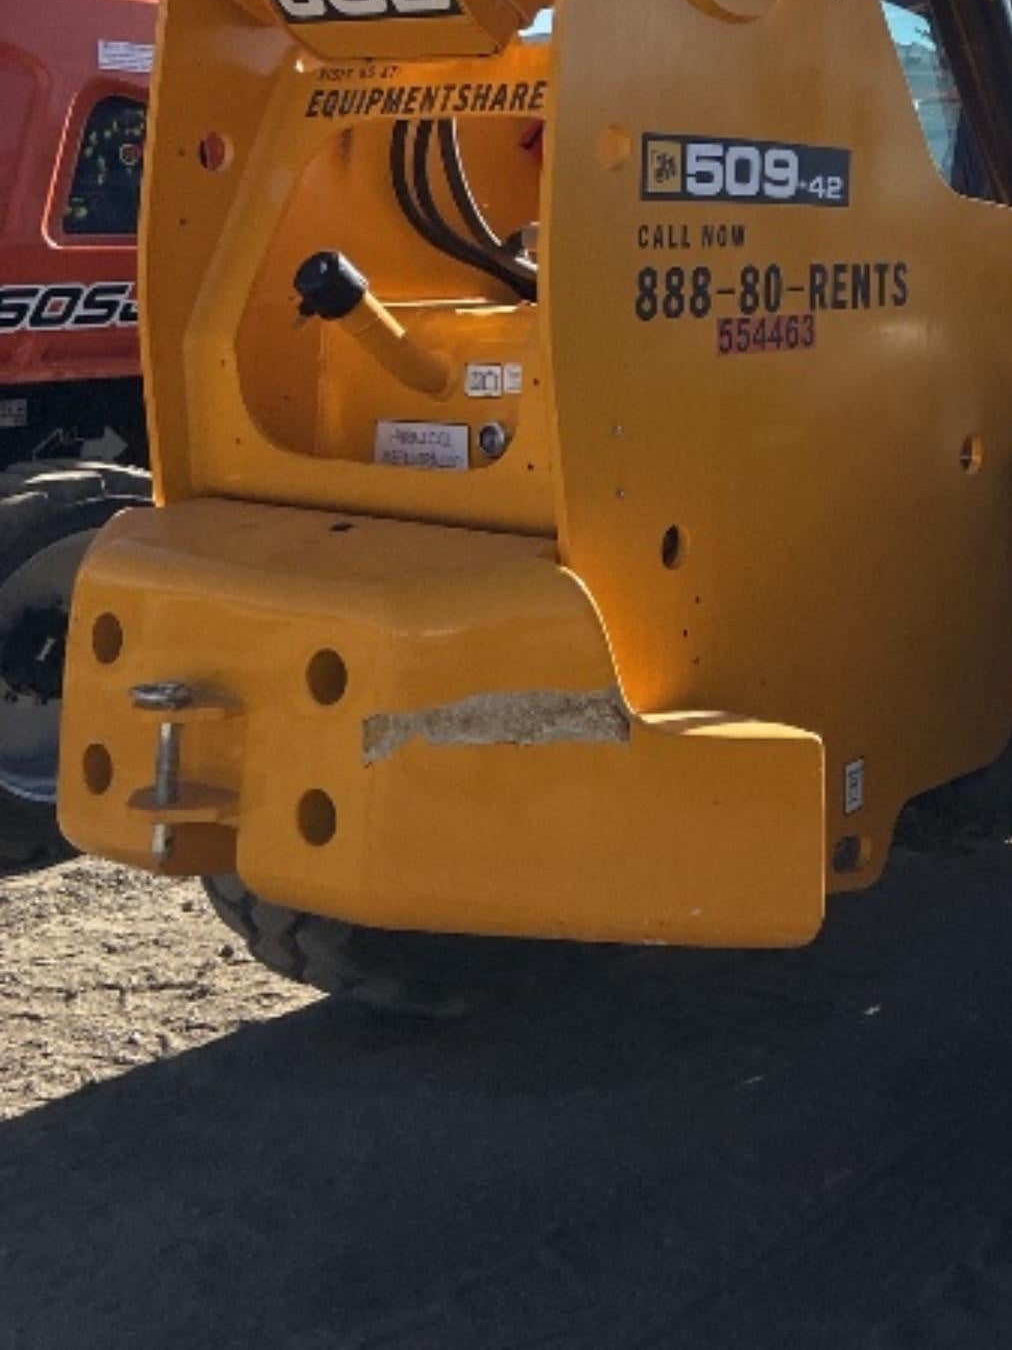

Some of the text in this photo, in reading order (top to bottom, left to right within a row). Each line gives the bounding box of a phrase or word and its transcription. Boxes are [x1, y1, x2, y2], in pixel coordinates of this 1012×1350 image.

[304, 81, 547, 119] EQUIPMENTSHARE
[638, 225, 745, 249] CALL NOW
[635, 260, 908, 321] 888-80-RENTS
[718, 314, 816, 355] 554463
